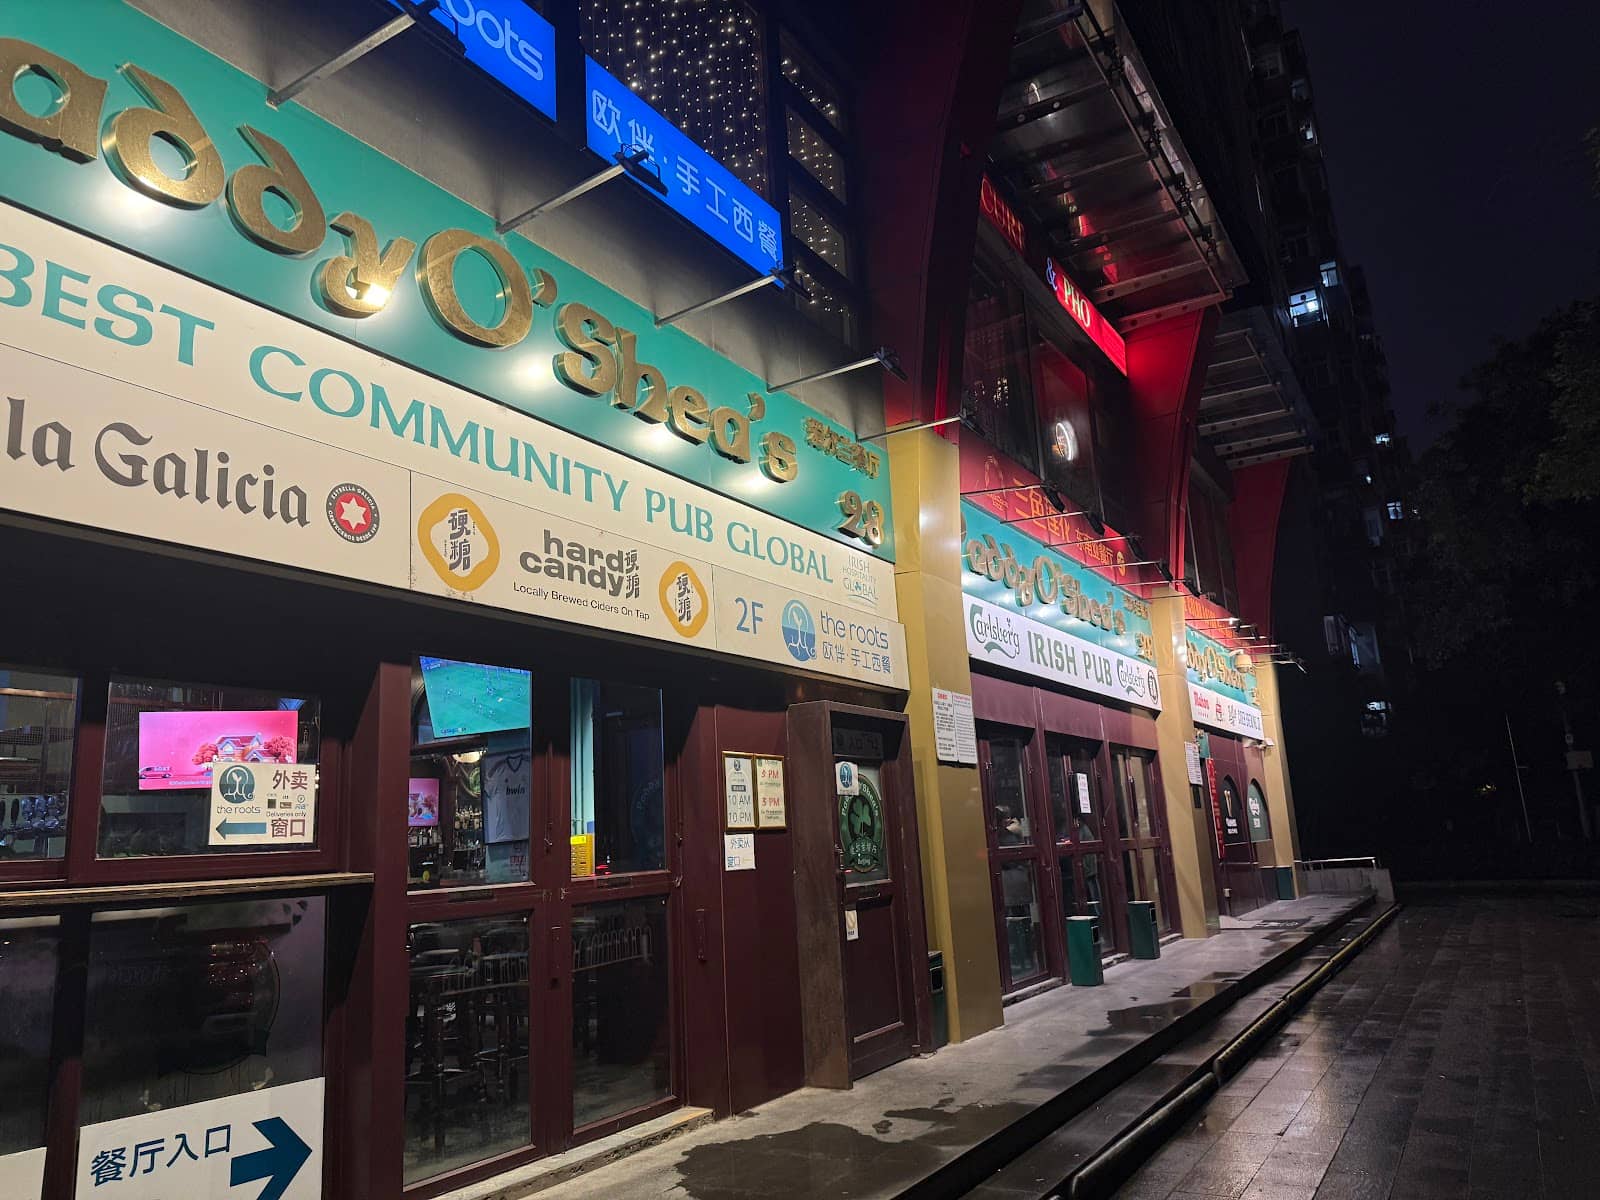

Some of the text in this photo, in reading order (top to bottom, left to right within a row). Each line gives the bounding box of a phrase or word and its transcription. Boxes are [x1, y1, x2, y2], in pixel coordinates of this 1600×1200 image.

[1063, 277, 1091, 327] PHO
[0, 243, 834, 583] BEST COMMUNITY PUB GLOBAL
[7, 397, 311, 528] la Galicia
[838, 490, 885, 547] 28
[543, 529, 624, 574] hard
[519, 551, 625, 597] candy
[513, 582, 651, 621] Locally Brewed Ciders On Tap
[735, 597, 765, 634] 2F
[820, 610, 889, 650] the roots
[970, 604, 1020, 657] Carlsberg
[1027, 631, 1078, 676] IRISH
[1083, 651, 1113, 687] PUB
[273, 769, 309, 791] 外卖
[768, 770, 779, 779] PM
[217, 805, 261, 815] the roots
[295, 811, 306, 819] only
[739, 795, 751, 806] AM
[768, 798, 780, 807] PM
[271, 818, 306, 838] 窗口
[90, 1124, 232, 1187] 餐厅入口
